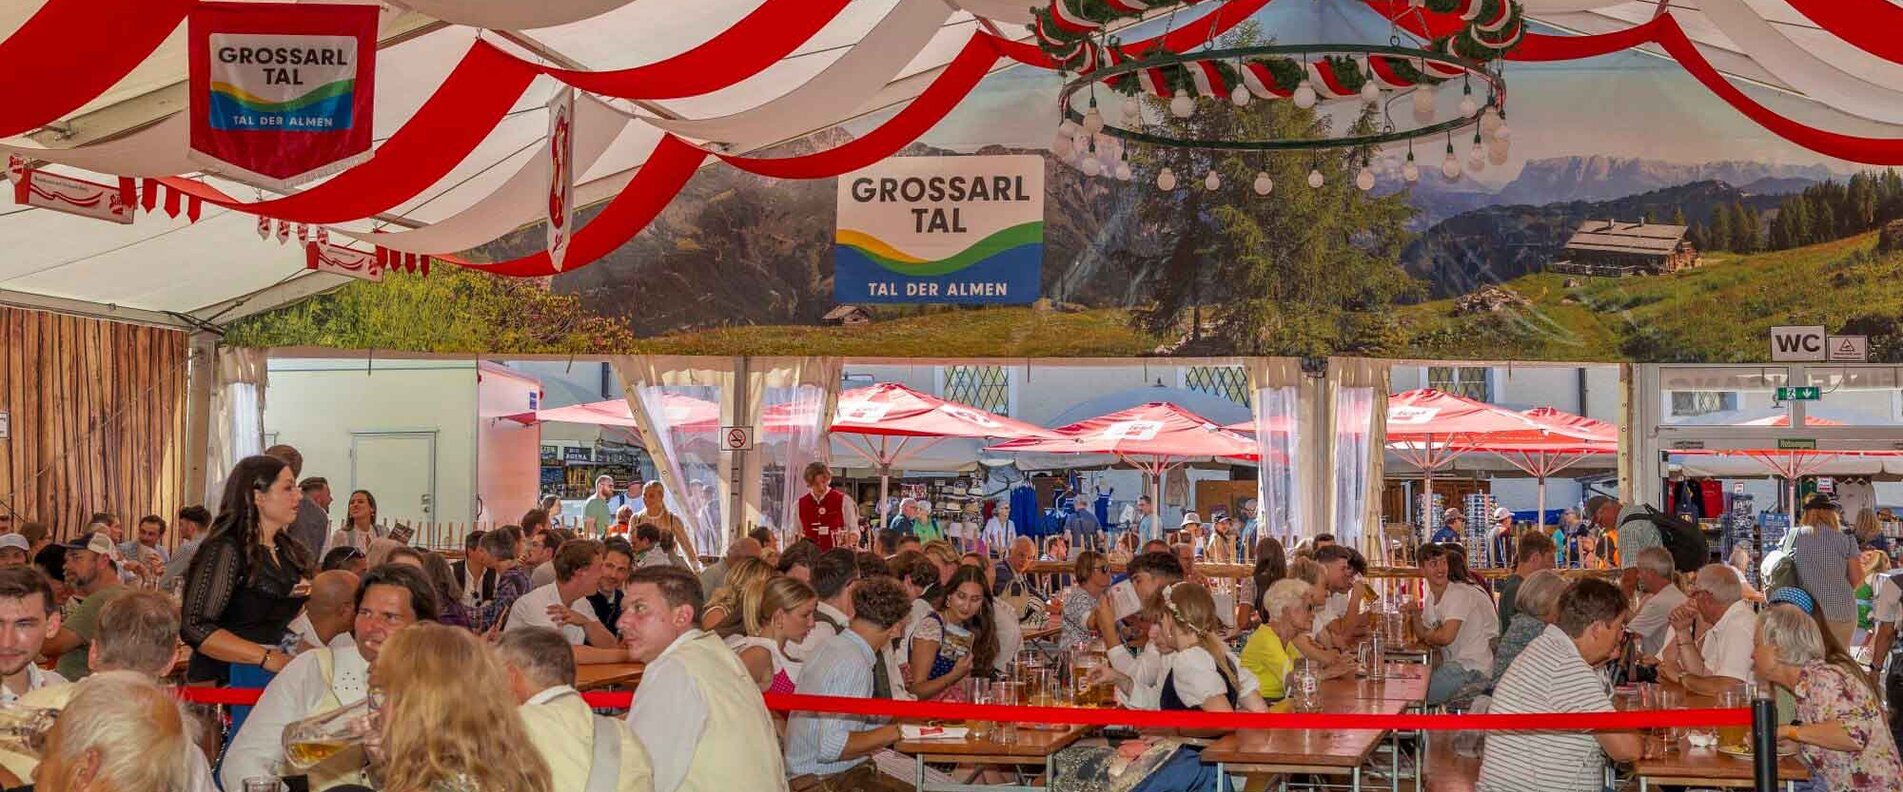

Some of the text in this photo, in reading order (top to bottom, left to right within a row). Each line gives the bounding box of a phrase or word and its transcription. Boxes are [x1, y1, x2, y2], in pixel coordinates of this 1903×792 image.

[218, 47, 348, 66] GROSSARL
[263, 68, 304, 85] TAL
[233, 115, 333, 127] TAL DER ALMEN
[852, 176, 1030, 202] GROSSARL
[911, 208, 967, 233] TAL
[868, 282, 1008, 296] TAL DER ALMEN
[1775, 333, 1821, 353] WC
